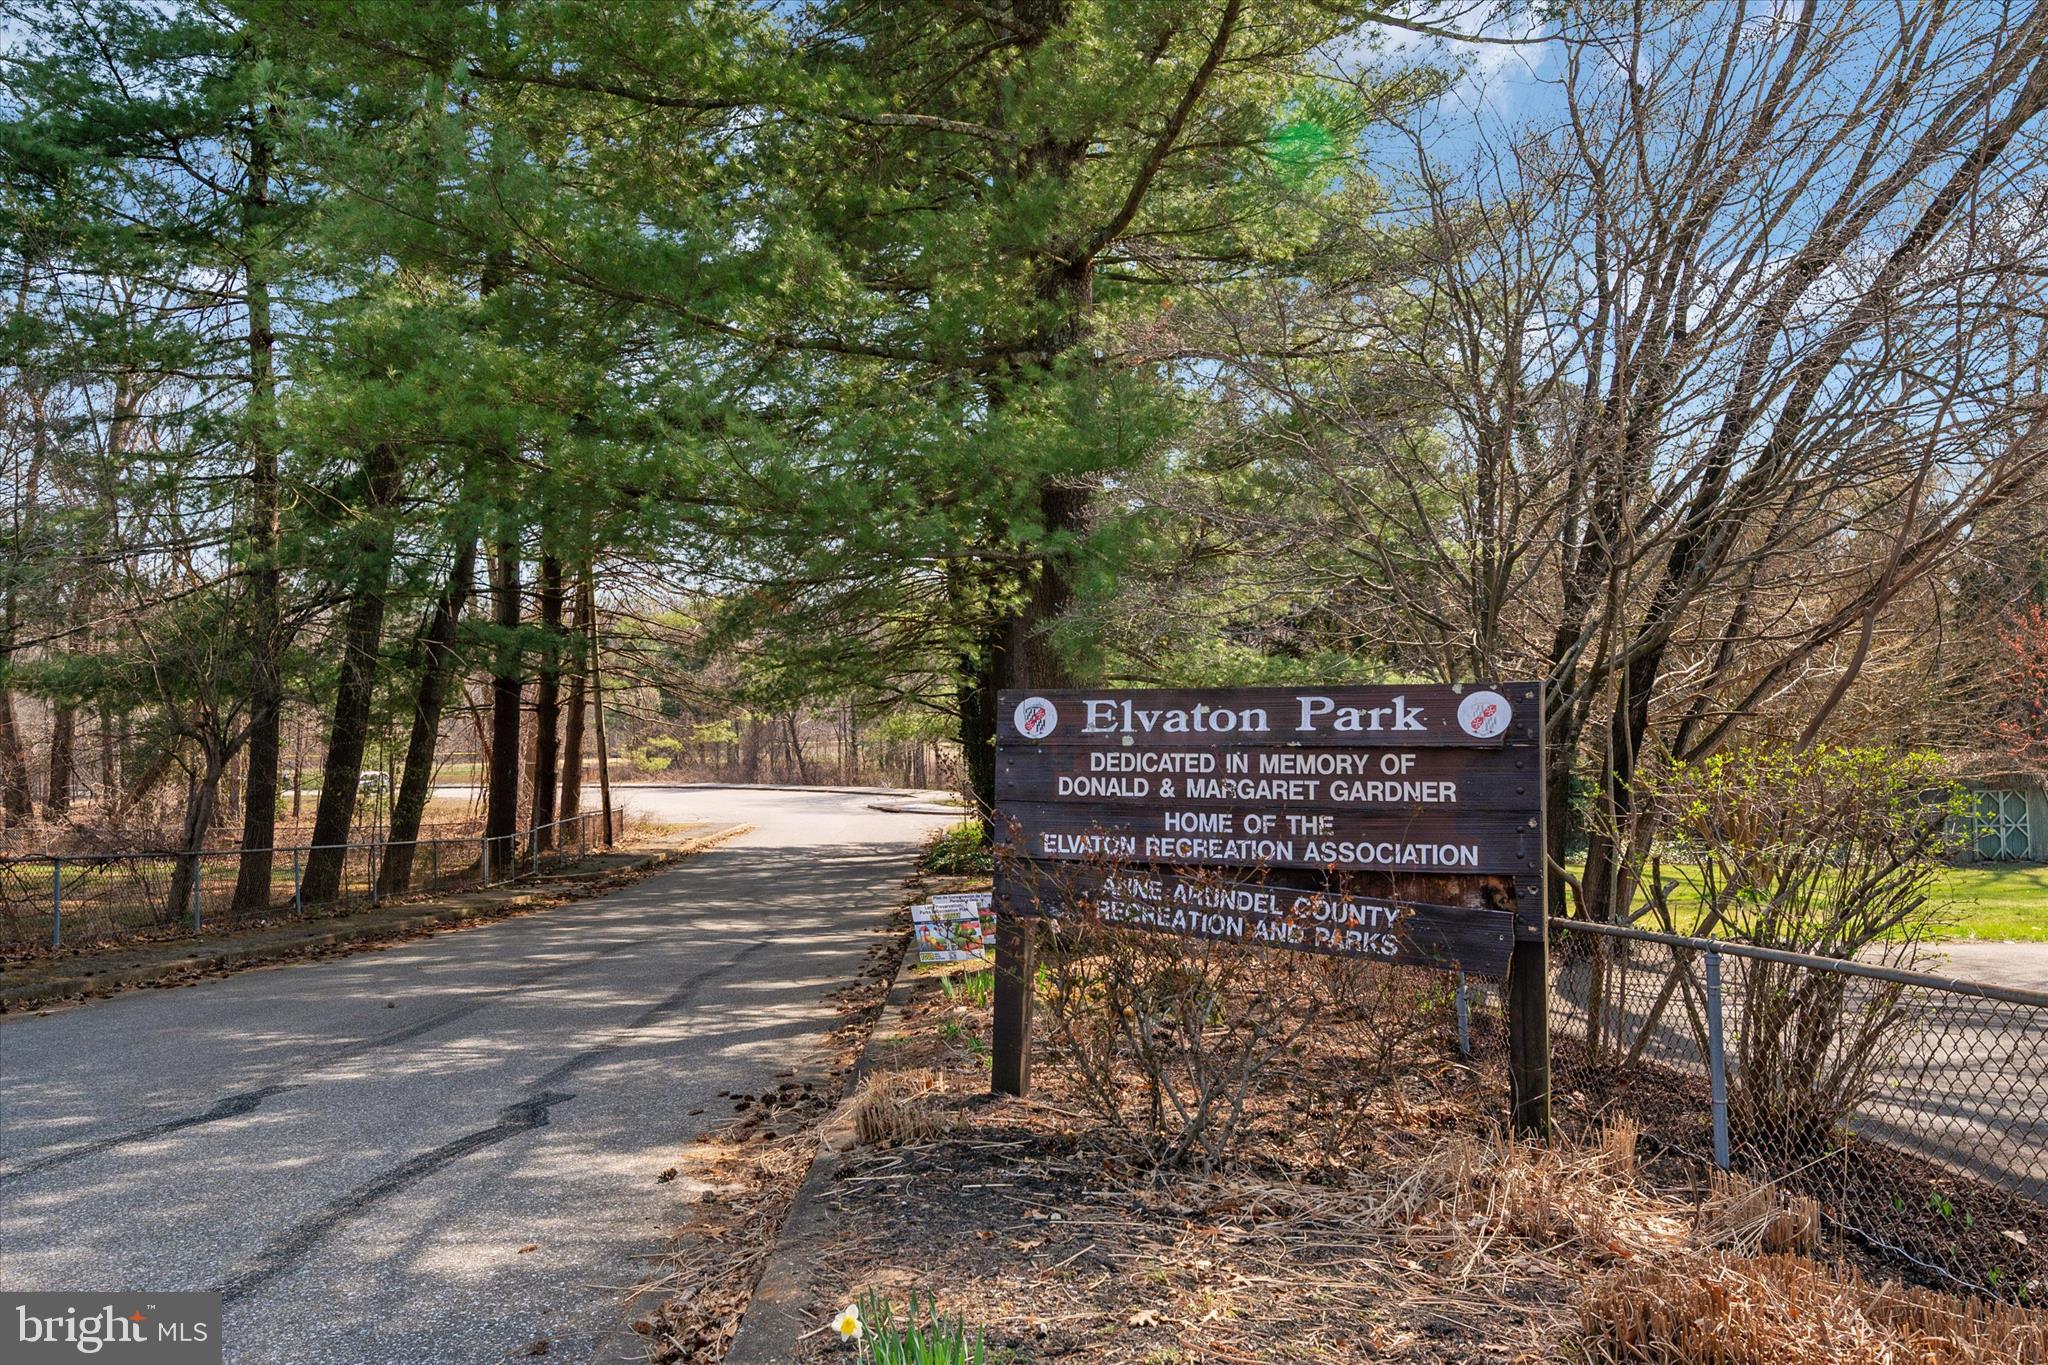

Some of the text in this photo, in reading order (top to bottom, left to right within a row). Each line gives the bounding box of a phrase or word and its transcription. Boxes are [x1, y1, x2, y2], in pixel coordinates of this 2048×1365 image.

[1081, 696, 1427, 733] Elvaton Park
[1090, 752, 1416, 775] DEDICATED IN MEMORY OF
[1058, 776, 1457, 803] DONALD & MARGARET GARDNER
[1165, 812, 1334, 836] HOME OF THE
[1043, 834, 1478, 866] ELVATON RECREATION ASSOCIATION
[1294, 896, 1401, 928] COUNTY
[1255, 919, 1305, 943] AND
